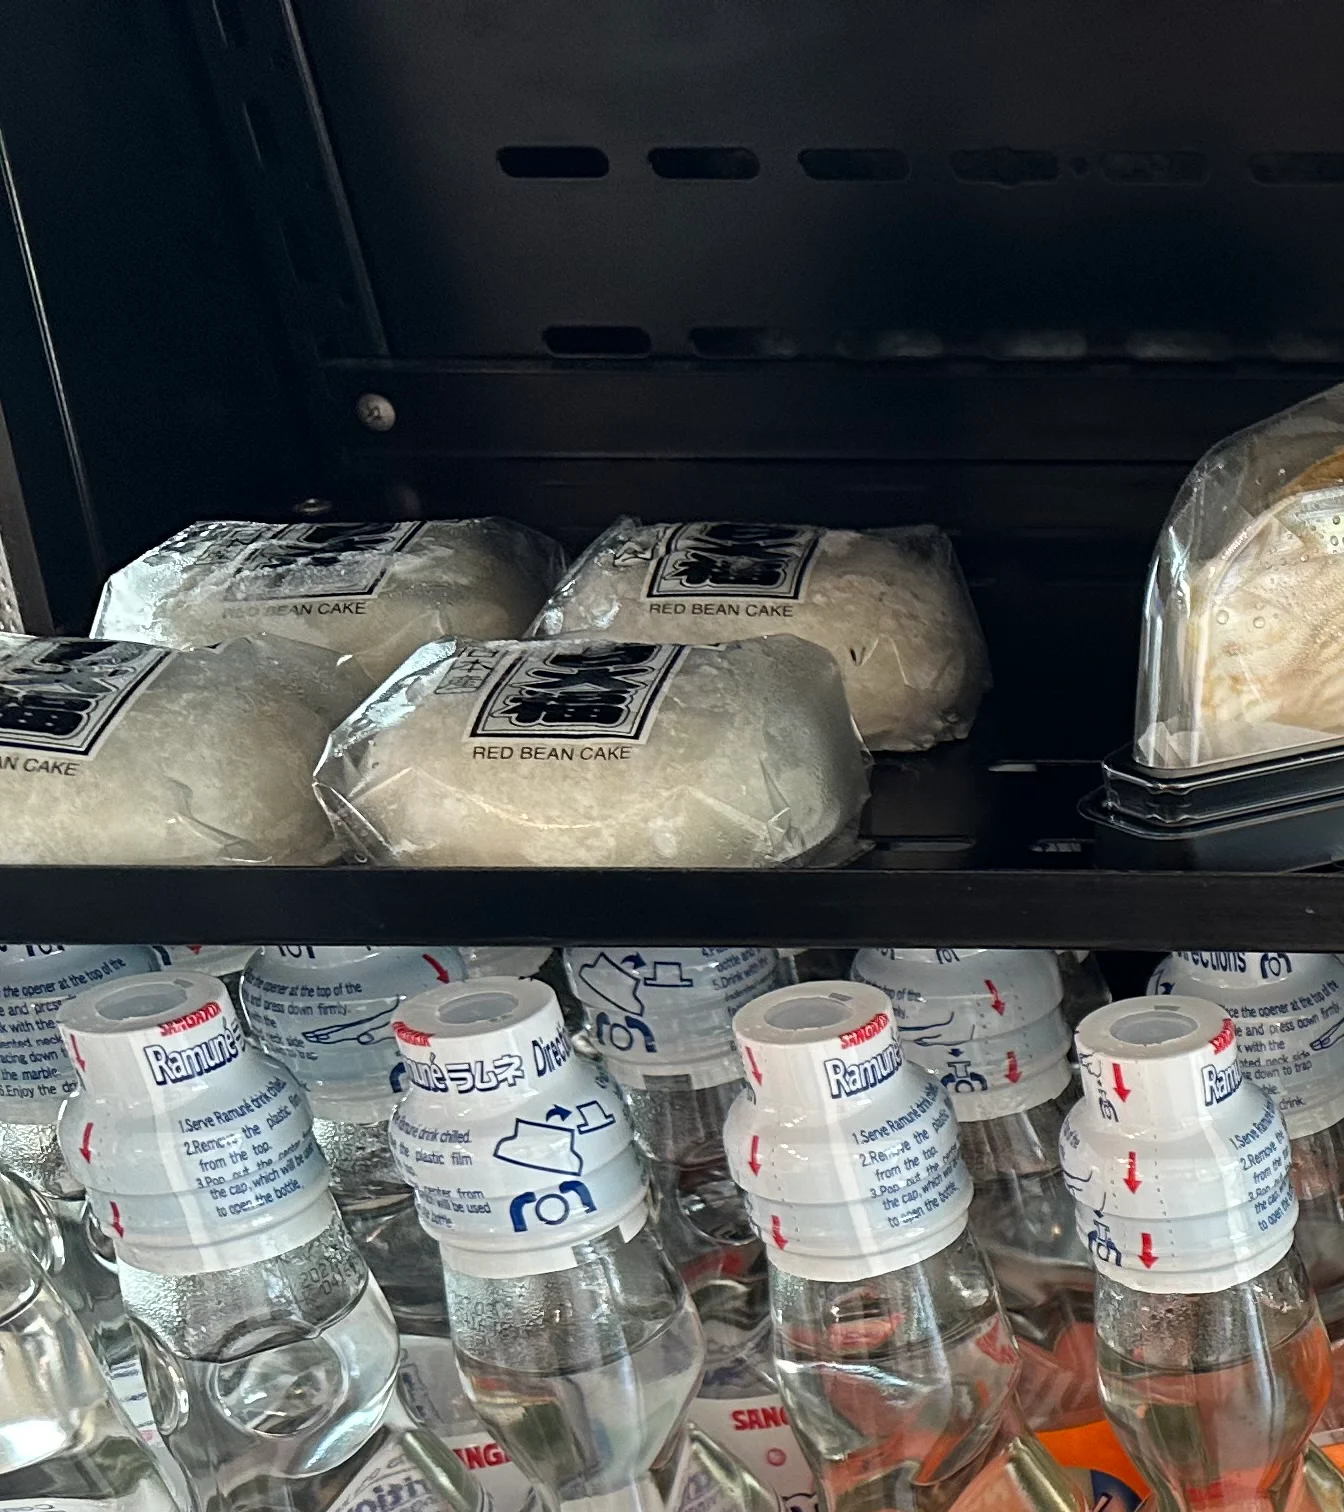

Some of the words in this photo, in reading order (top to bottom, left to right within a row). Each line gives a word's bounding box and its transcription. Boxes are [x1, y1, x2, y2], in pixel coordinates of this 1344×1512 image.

[319, 602, 366, 614] CAKE
[650, 603, 686, 615] RED
[692, 603, 739, 616] BEAN
[746, 604, 793, 617] CAKE
[472, 746, 514, 760] RED
[520, 746, 574, 760] BEAN
[580, 746, 632, 760] CAKE
[23, 758, 80, 776] CAKE
[446, 1053, 524, 1094] ラムネ
